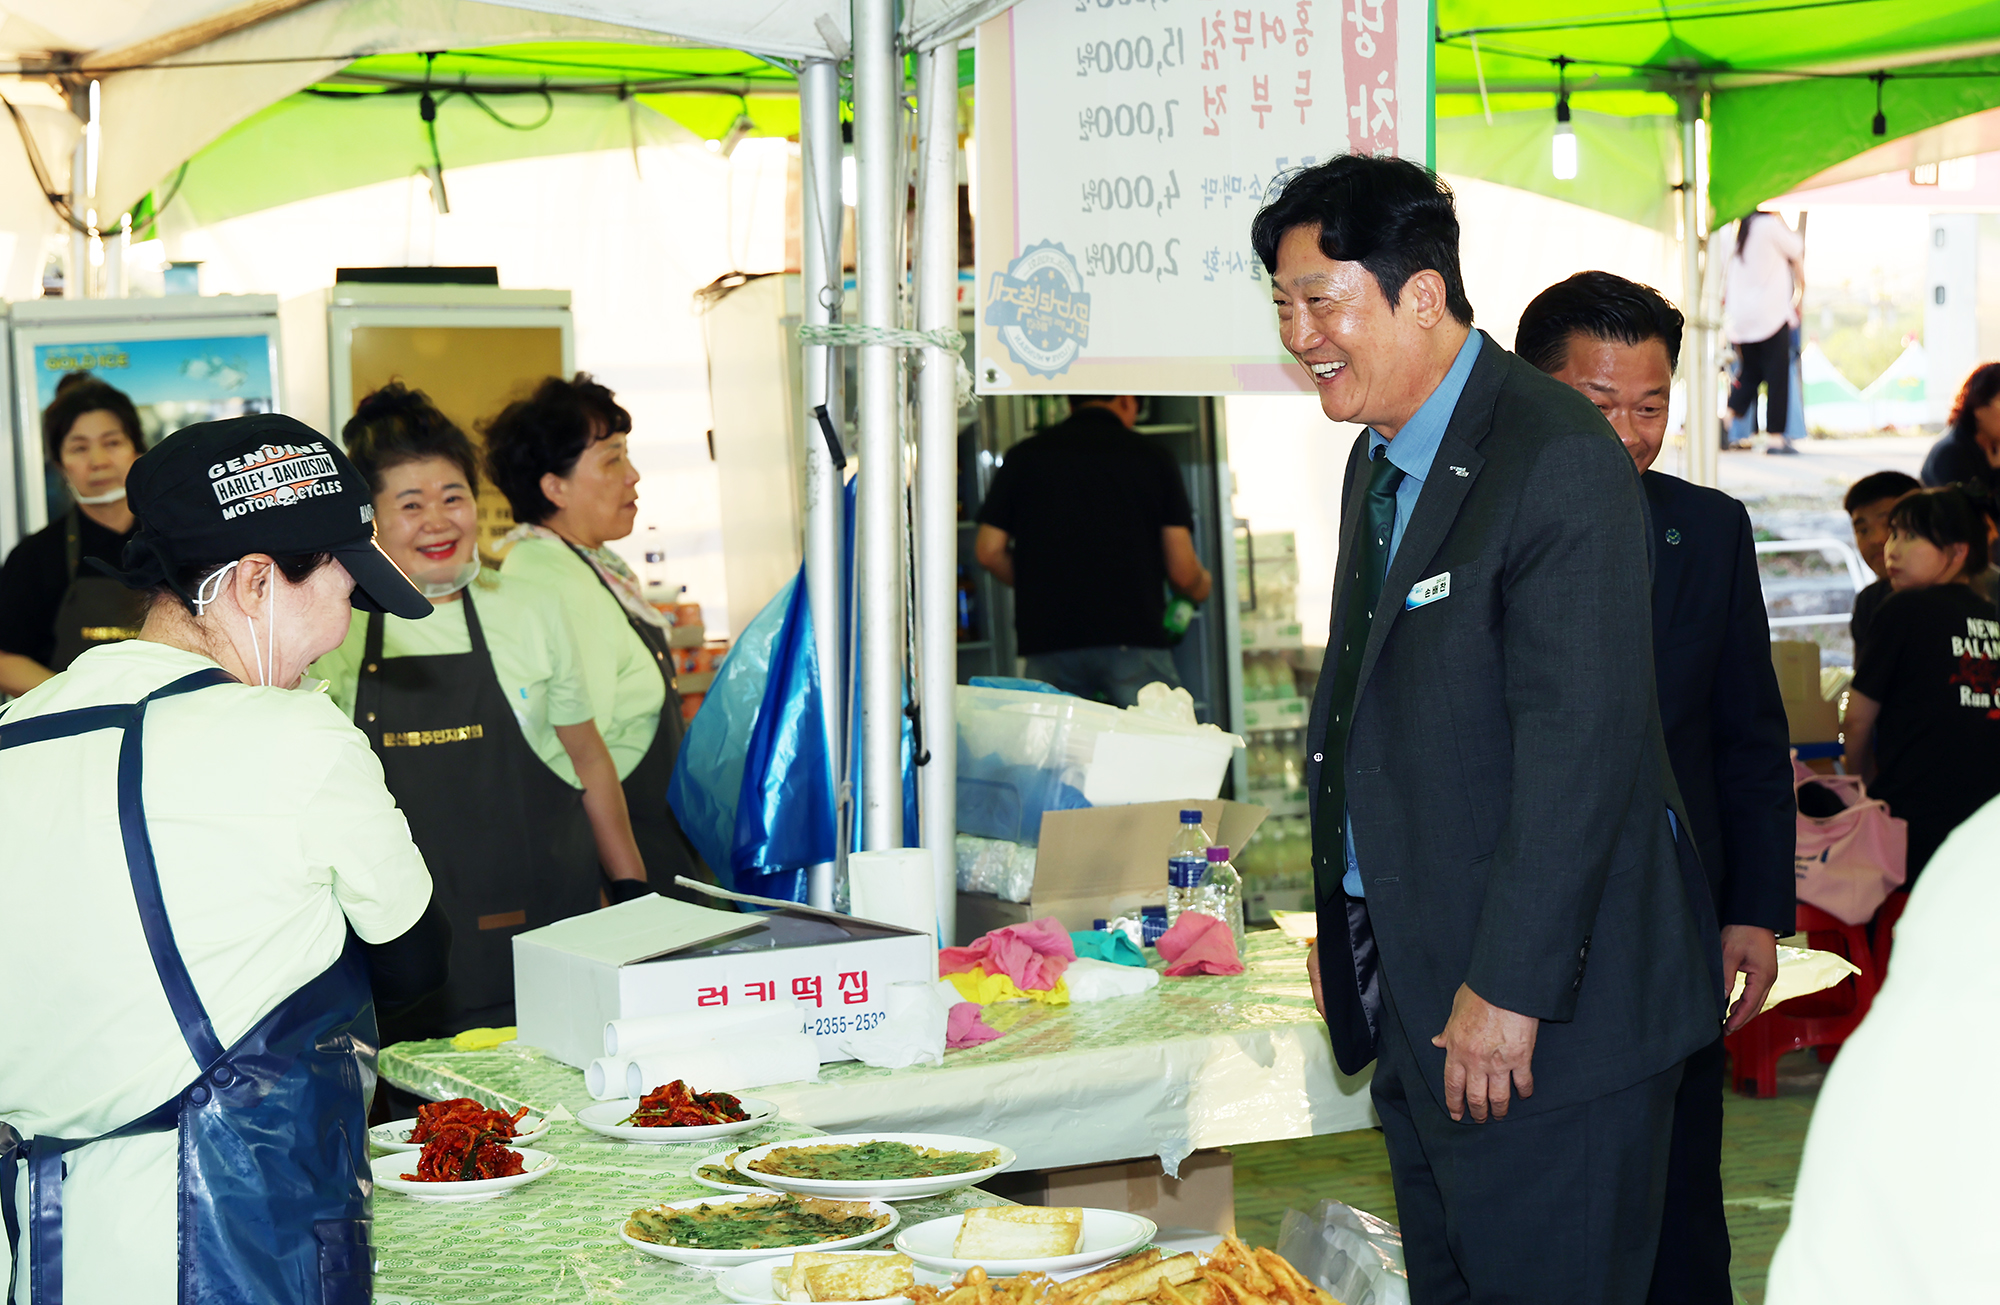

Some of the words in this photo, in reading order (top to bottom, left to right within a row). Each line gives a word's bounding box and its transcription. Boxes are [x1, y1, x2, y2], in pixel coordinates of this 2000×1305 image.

[46, 354, 96, 371] GOLD
[98, 353, 129, 369] ICE
[208, 441, 328, 480] GENUINE
[216, 457, 335, 502] HARLEY-DAVIDSON
[1966, 617, 2000, 640] NEW
[1959, 684, 1991, 708] Run
